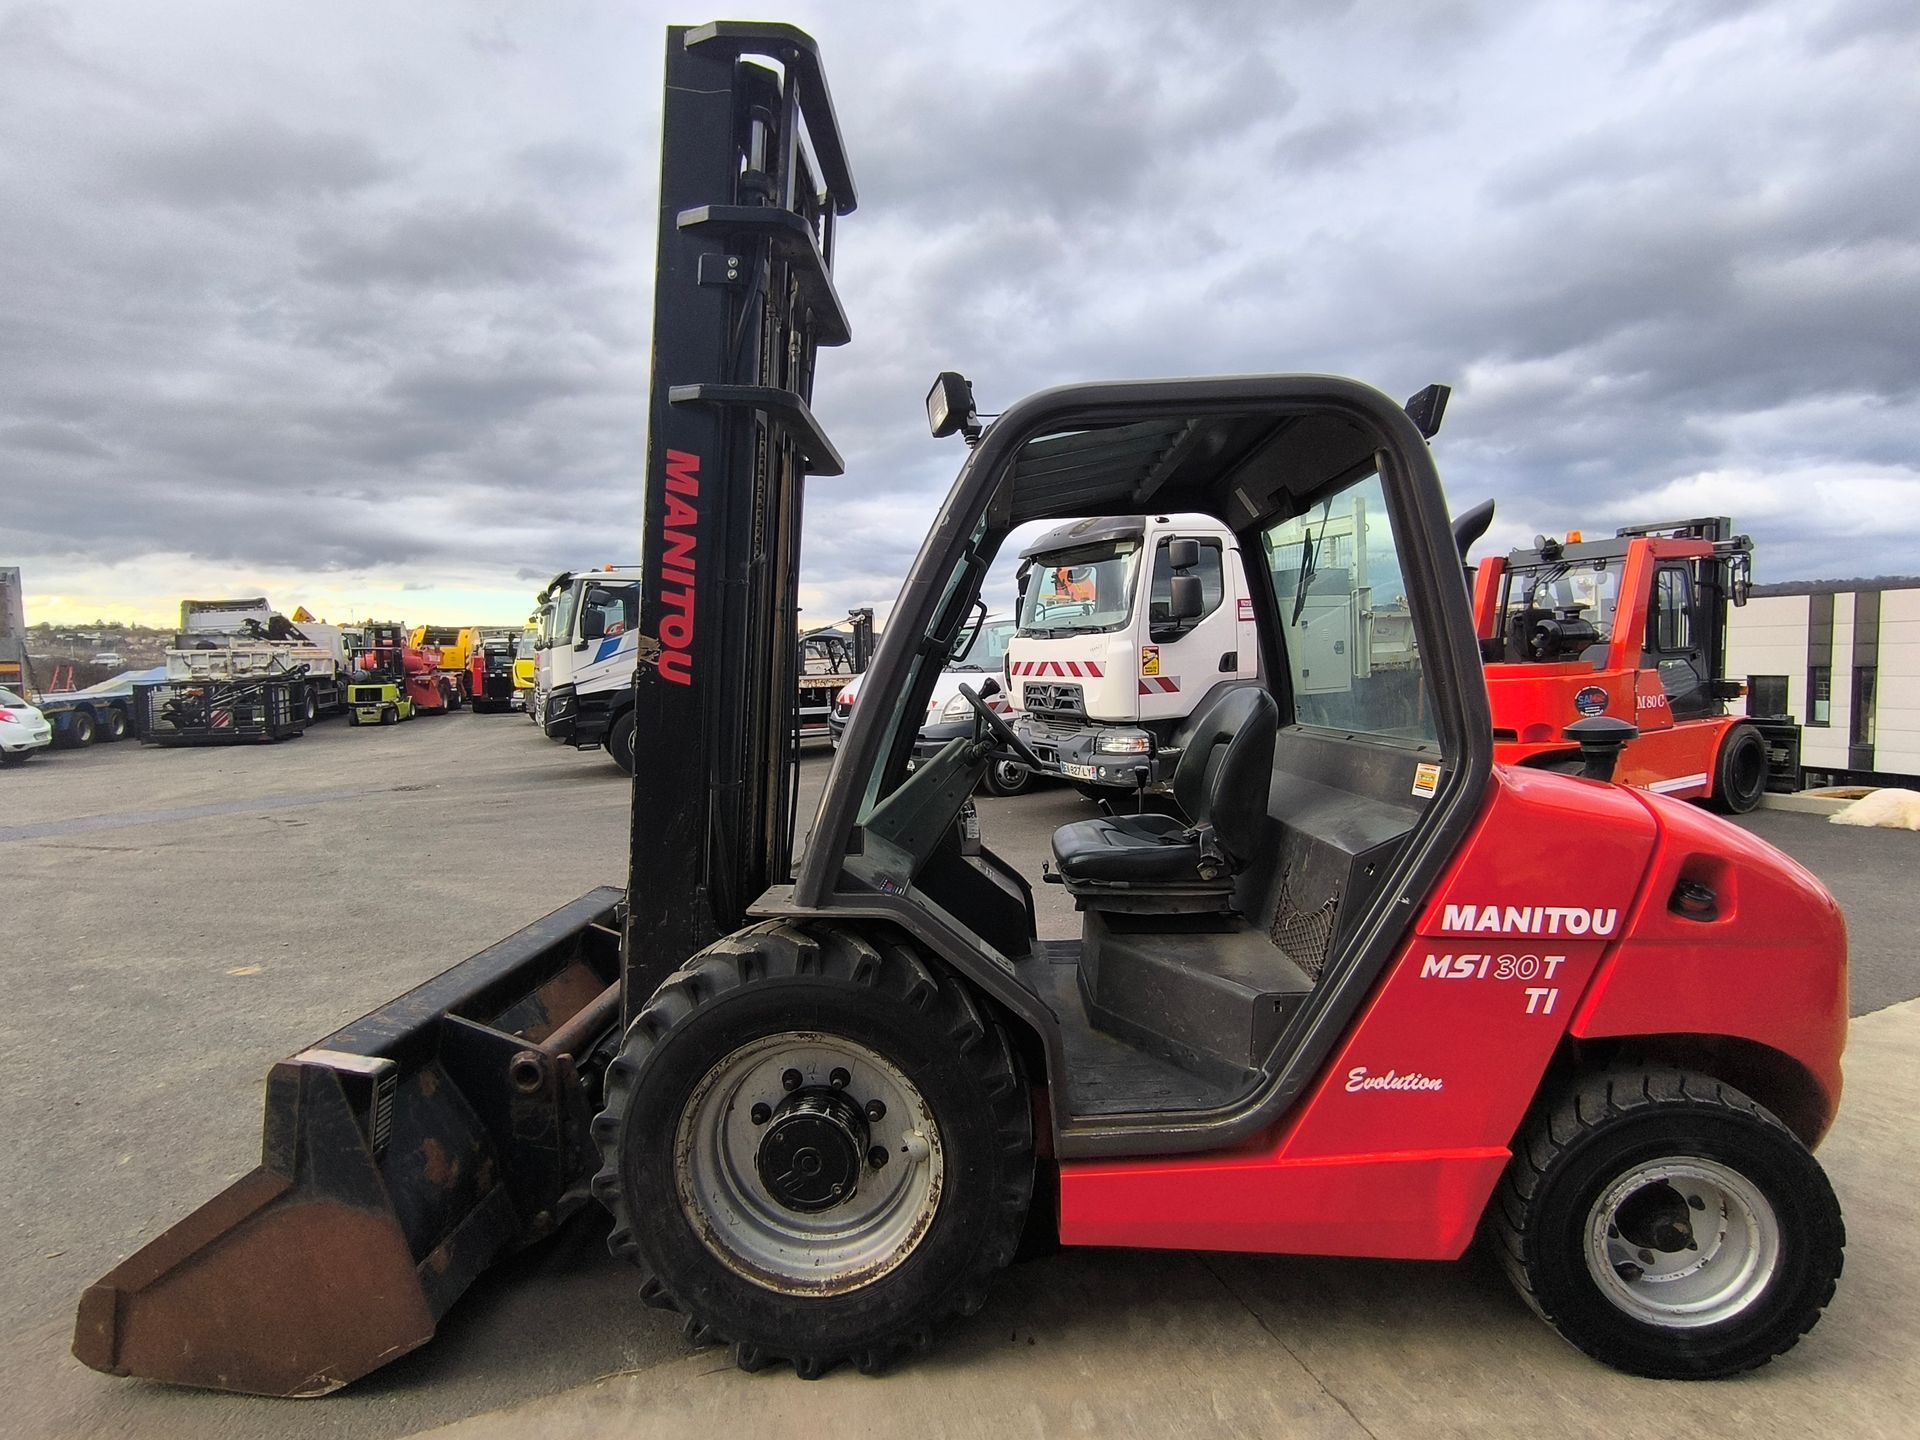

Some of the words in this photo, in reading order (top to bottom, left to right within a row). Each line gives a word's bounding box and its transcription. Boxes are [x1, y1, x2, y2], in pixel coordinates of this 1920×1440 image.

[657, 448, 701, 686] MANITOU
[1441, 904, 1617, 936] MANITOU
[1420, 954, 1491, 979] MSI
[1493, 953, 1540, 980] 30
[1543, 955, 1566, 980] T
[1524, 987, 1559, 1014] TI
[1345, 1066, 1443, 1092] Evolution
